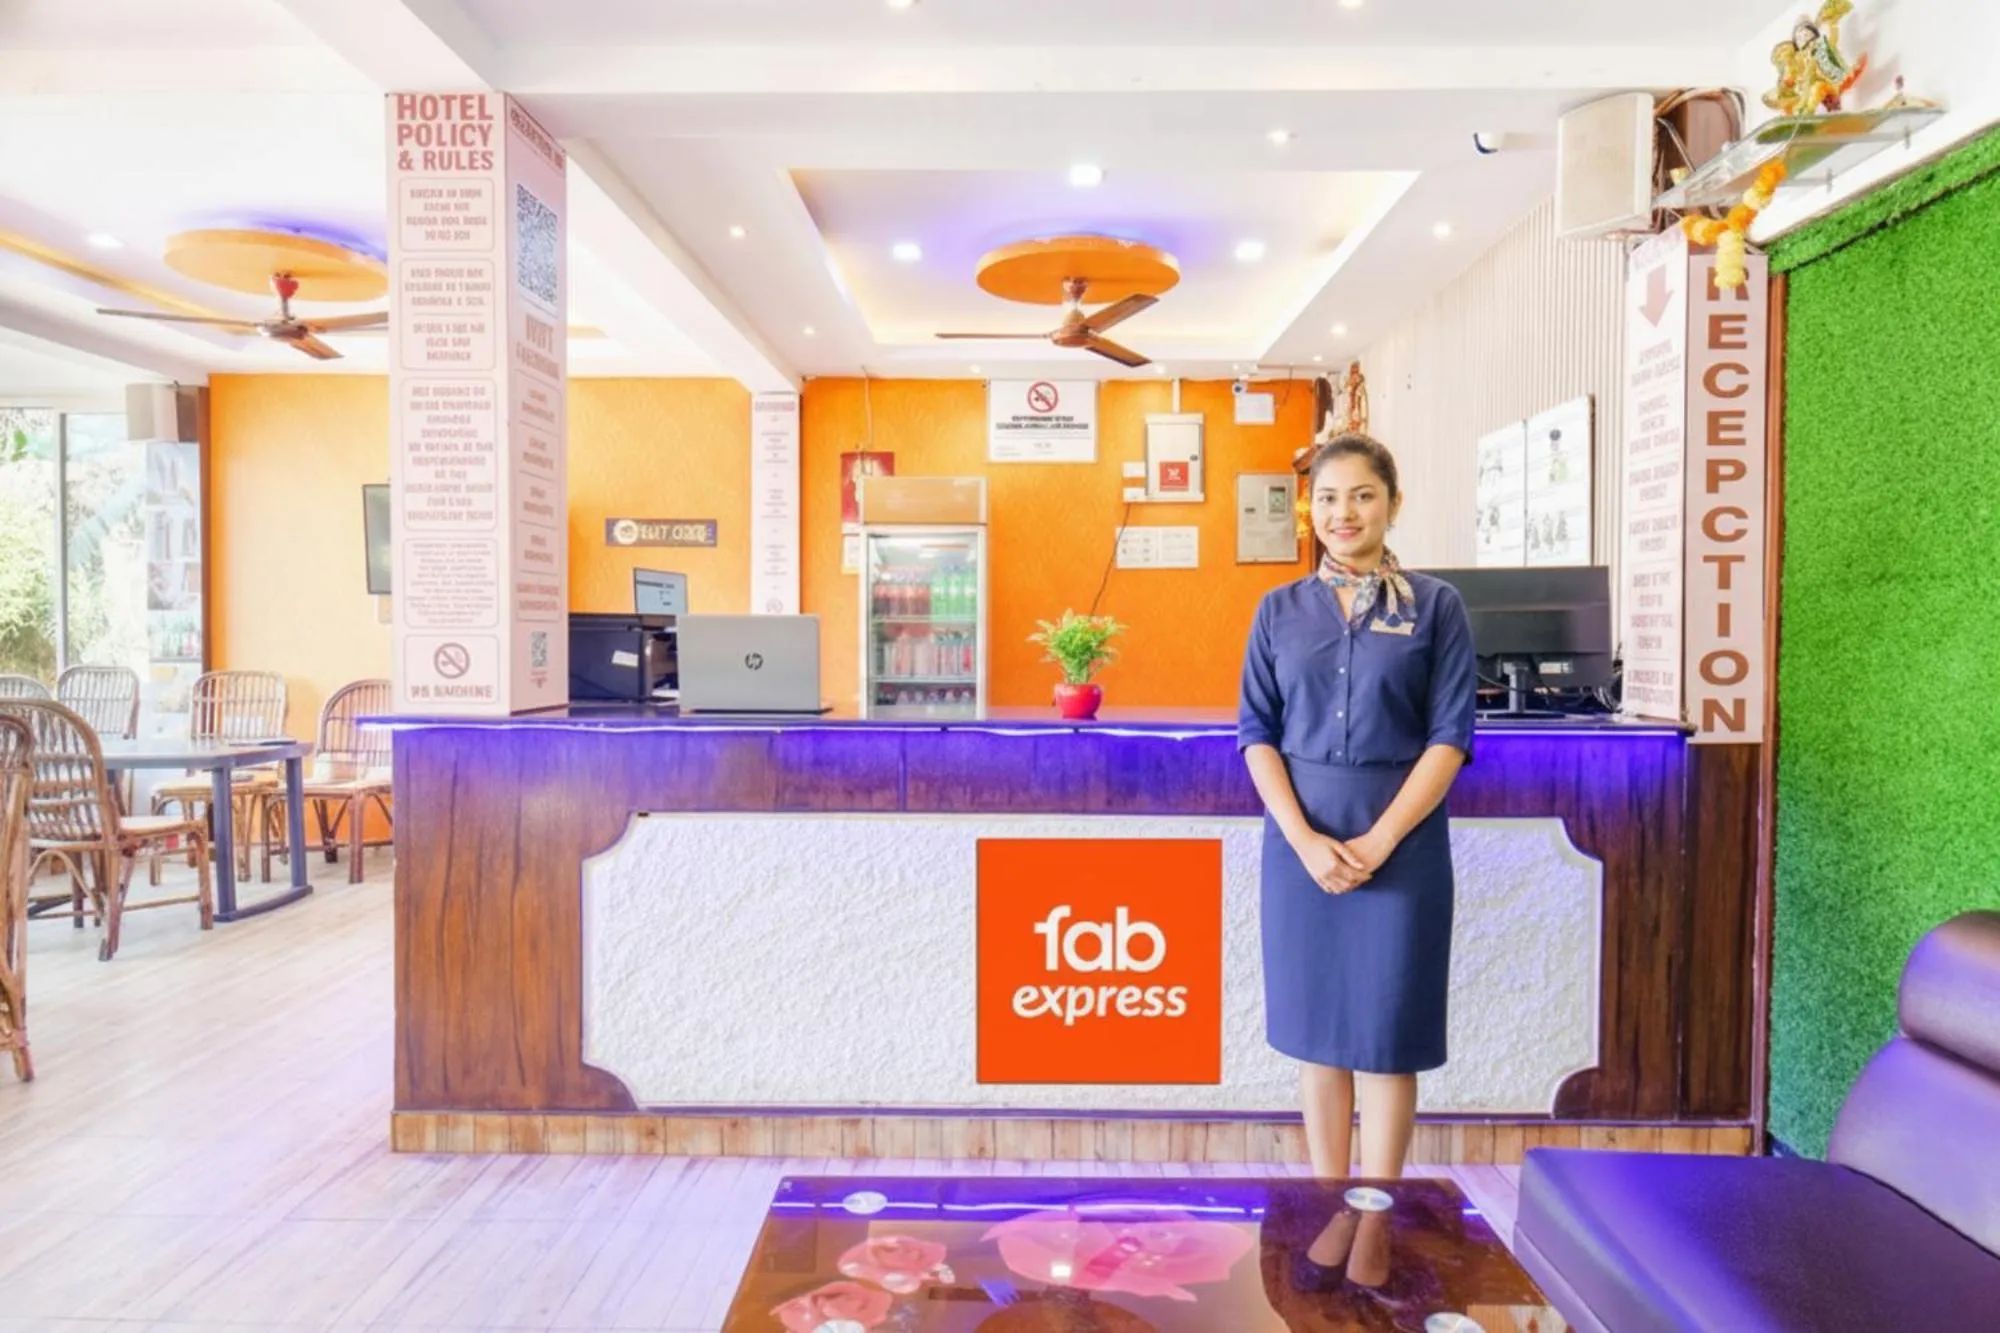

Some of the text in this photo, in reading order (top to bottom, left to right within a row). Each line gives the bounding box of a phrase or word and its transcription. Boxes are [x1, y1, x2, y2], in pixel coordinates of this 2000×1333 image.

[397, 94, 493, 121] HOTEL
[397, 123, 493, 147] POLICY
[397, 150, 494, 171] & RULES
[1034, 904, 1167, 972] fab
[1012, 985, 1189, 1026] express
